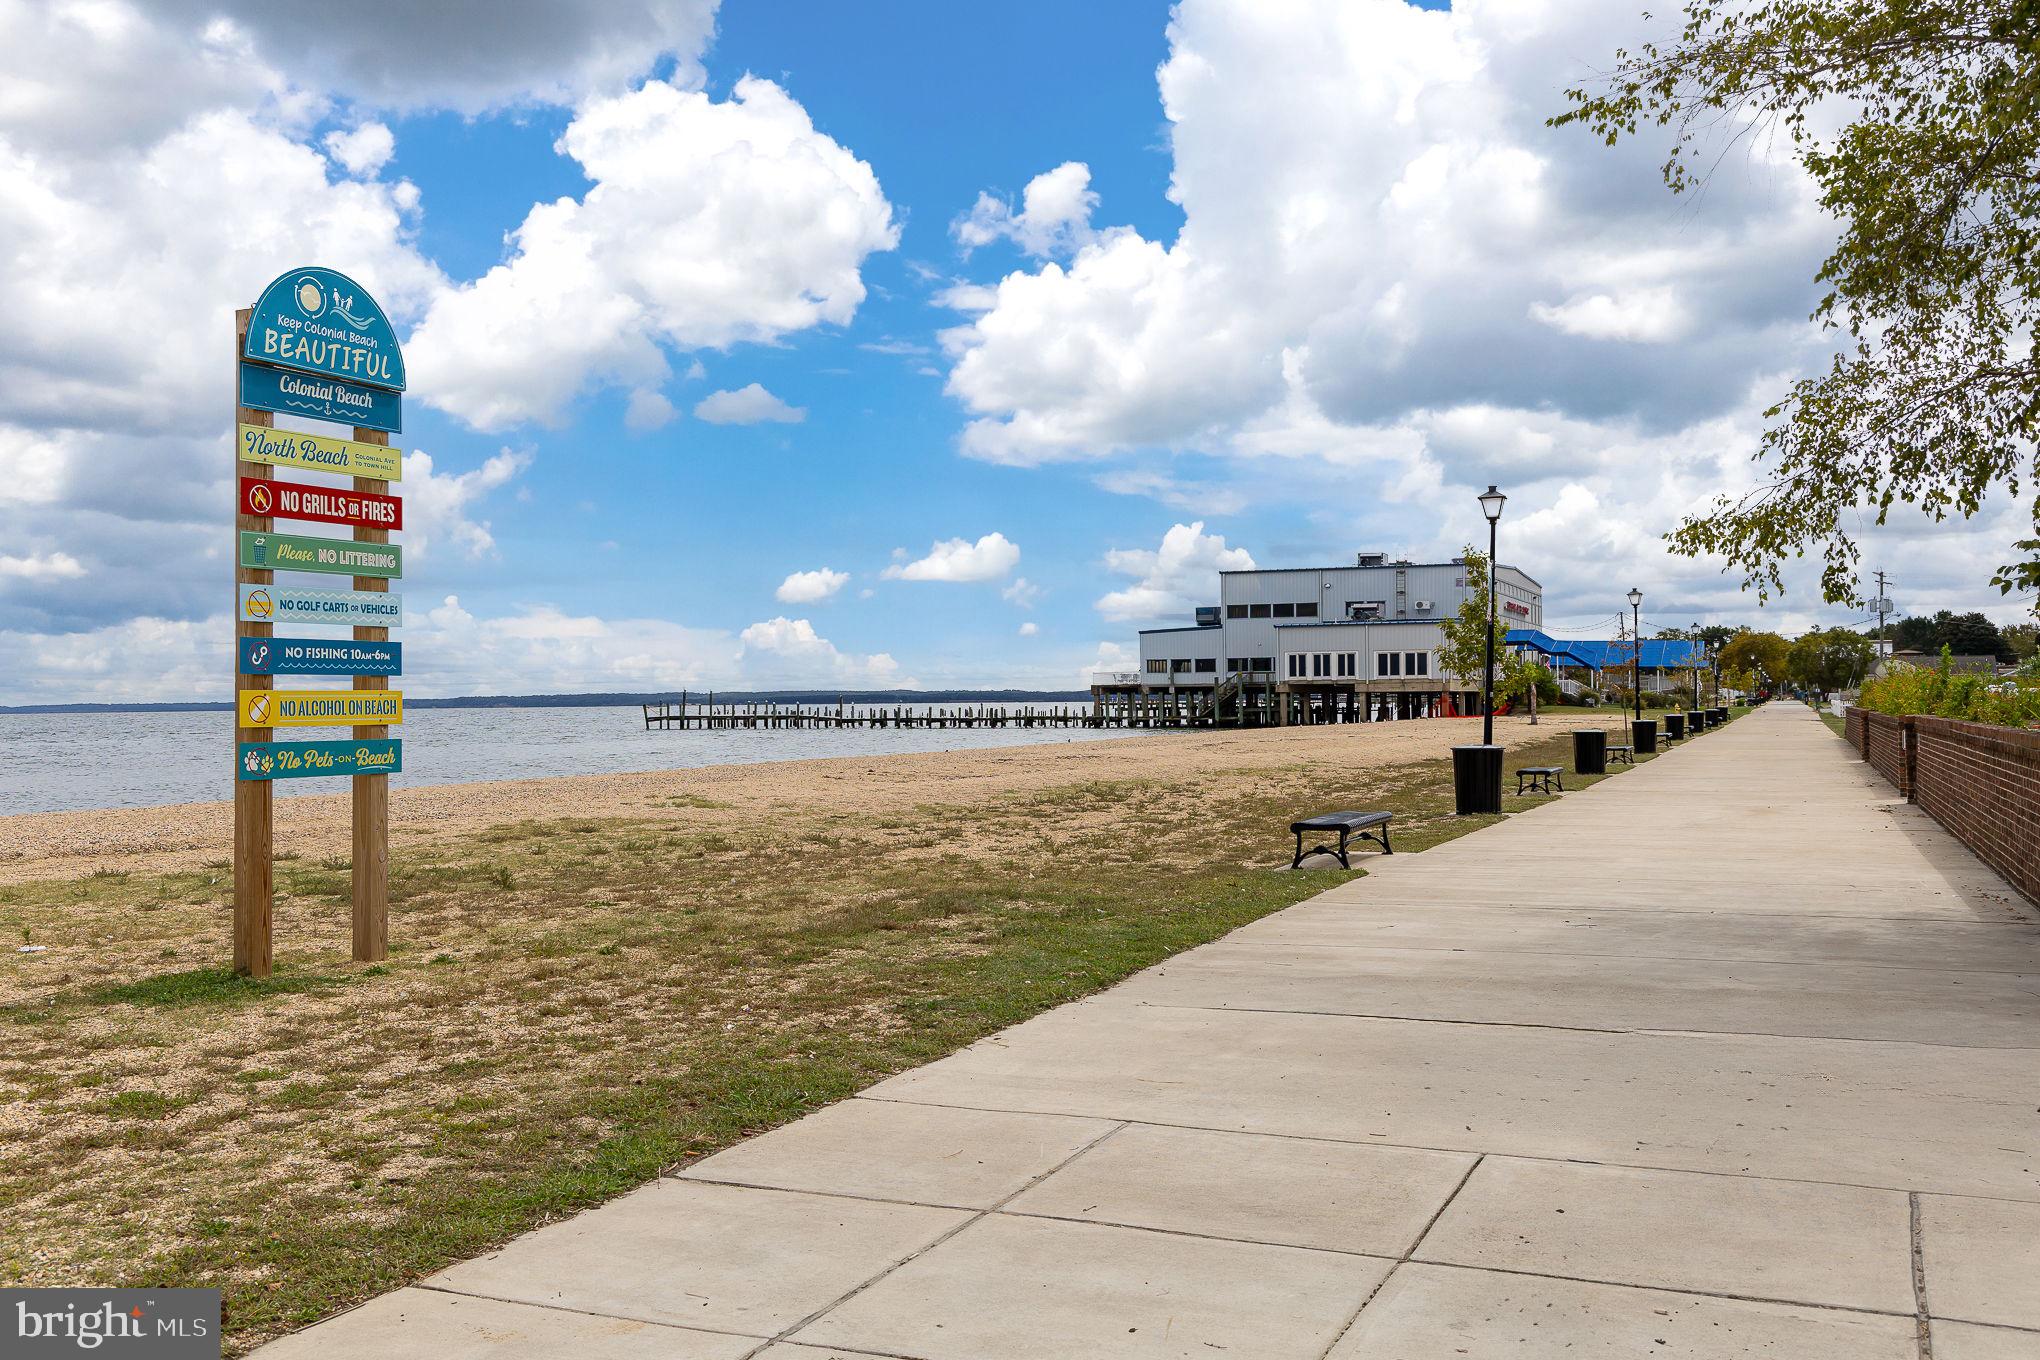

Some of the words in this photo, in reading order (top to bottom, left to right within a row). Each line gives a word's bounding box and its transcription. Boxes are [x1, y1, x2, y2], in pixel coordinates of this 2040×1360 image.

[277, 314, 302, 333] Keep
[304, 321, 347, 341] Colonial
[349, 332, 378, 348] Beach
[264, 327, 391, 379] BEAUTIFUL
[279, 375, 333, 400] Colonial
[335, 386, 373, 408] Beach
[245, 431, 297, 459] North
[300, 439, 350, 467] Beach
[281, 491, 299, 512] NO
[302, 492, 346, 517] GRILLS
[348, 503, 359, 515] OR
[362, 501, 395, 522] FIRES
[318, 549, 337, 563] NO
[340, 550, 395, 568] LITTERING
[280, 599, 294, 610] NO
[297, 600, 321, 612] GOLF
[323, 601, 349, 613] CARTS
[361, 604, 398, 615] VEHICLES
[285, 647, 303, 658] NO
[306, 648, 347, 659] FISHING
[280, 700, 296, 716] NO
[298, 700, 347, 716] ALCOHOL
[348, 700, 363, 715] ON
[364, 700, 397, 715] BEACH
[277, 750, 302, 769] No
